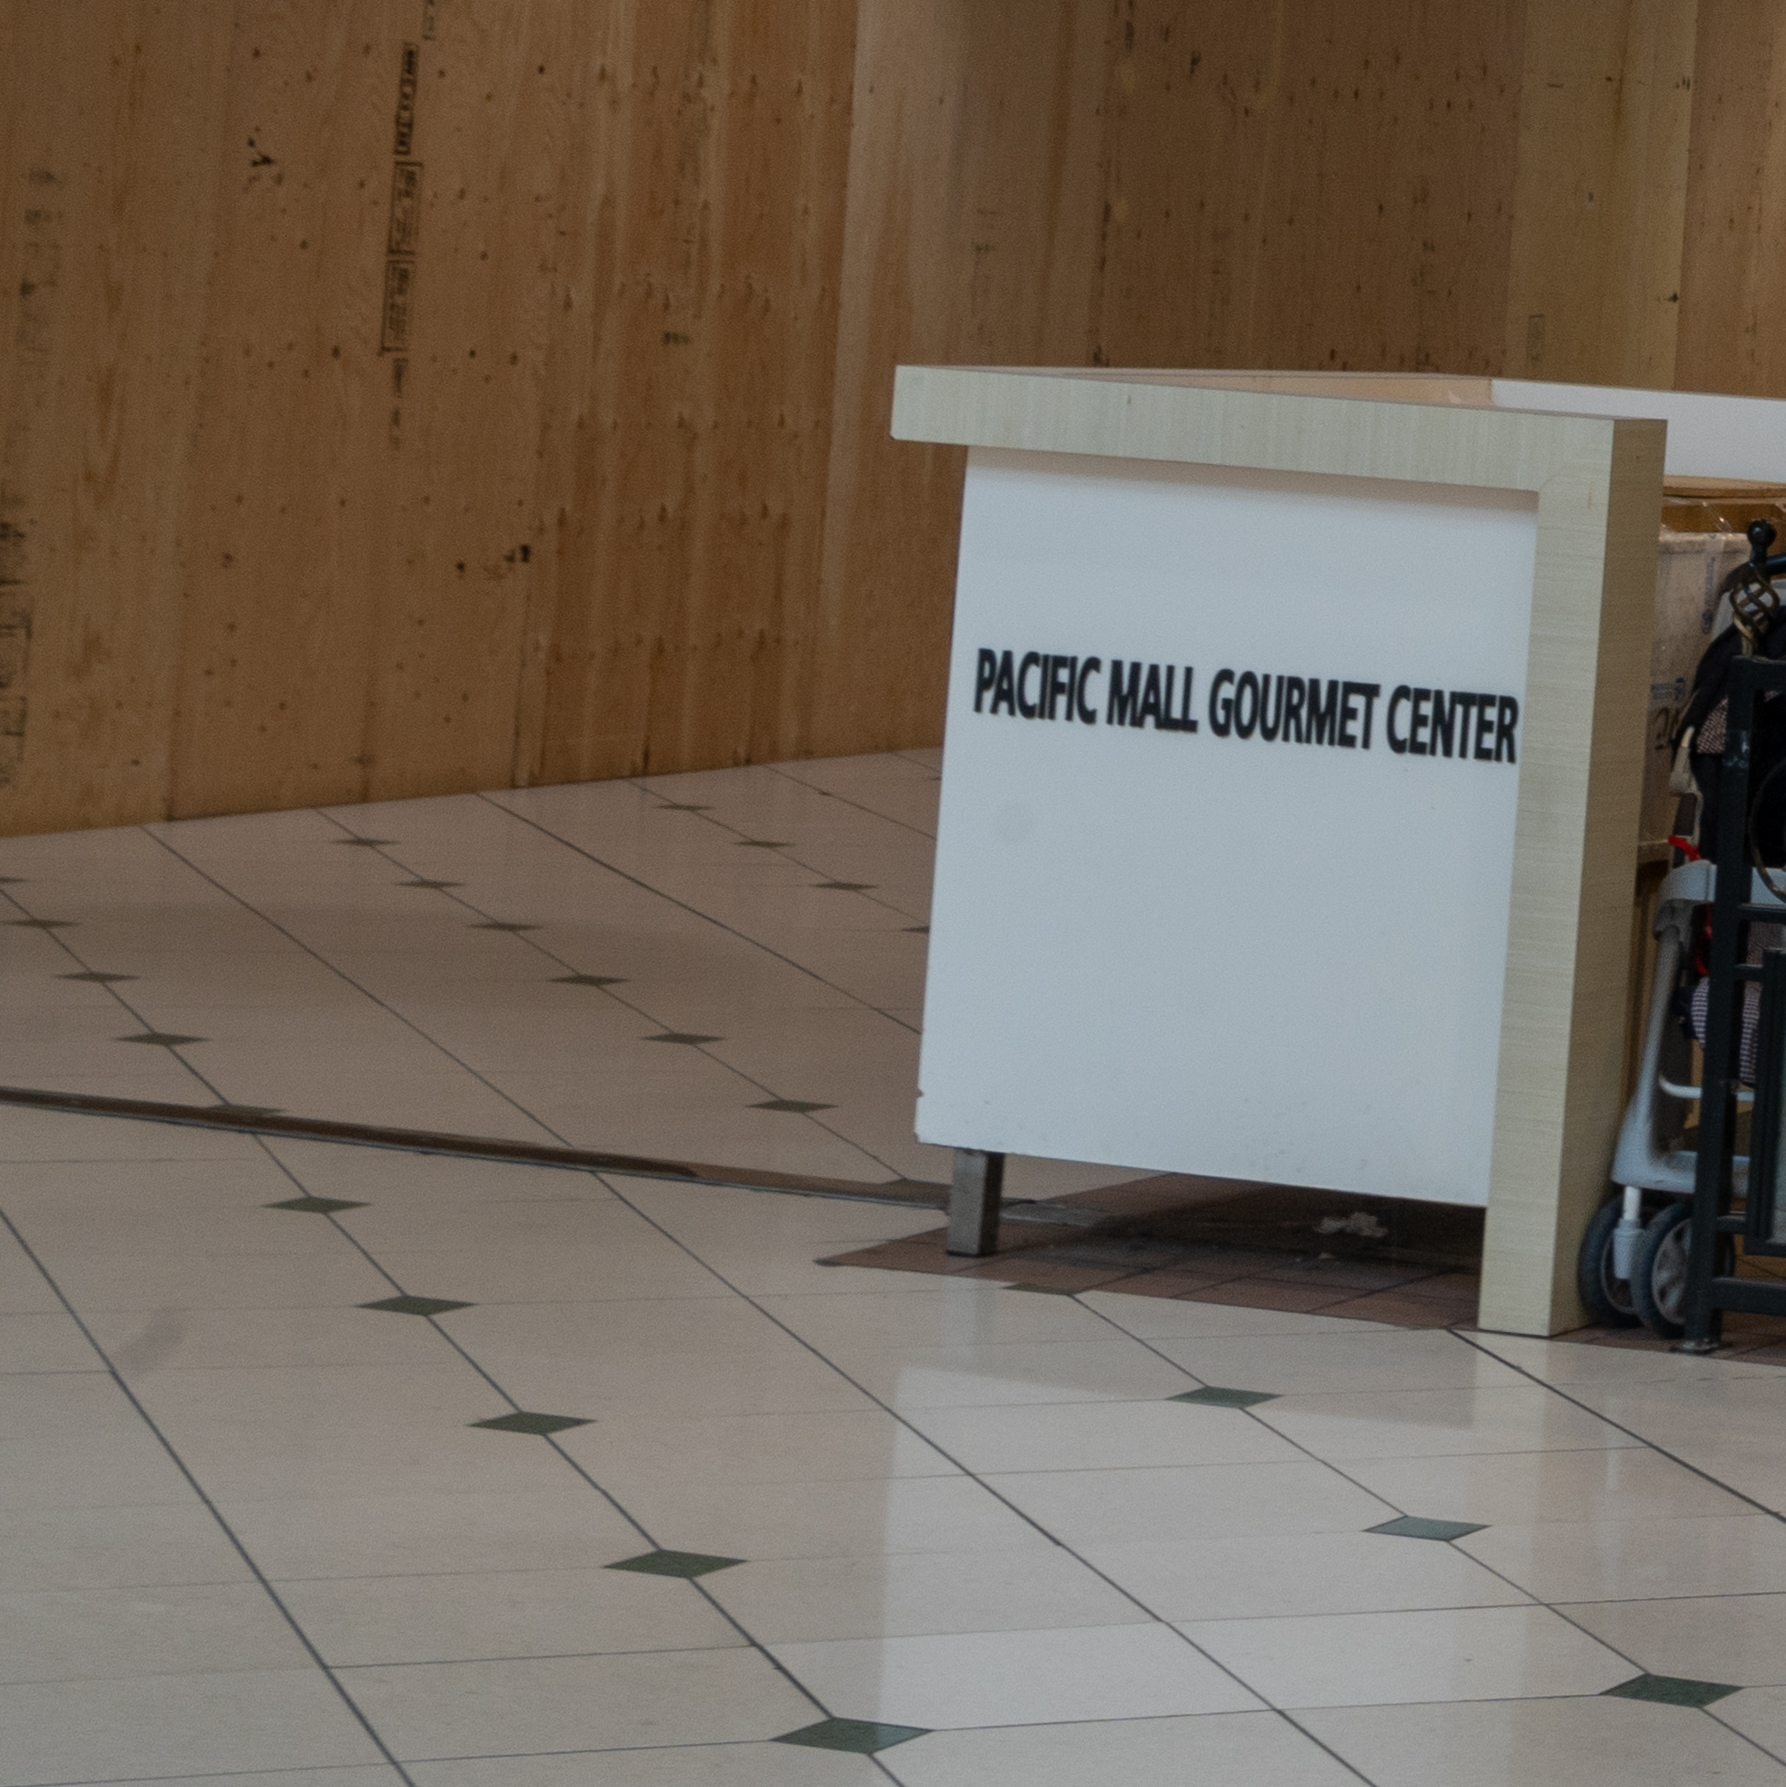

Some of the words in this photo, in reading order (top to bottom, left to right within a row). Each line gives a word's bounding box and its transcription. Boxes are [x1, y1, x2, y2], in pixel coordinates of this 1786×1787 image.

[972, 646, 1102, 725] PACIFIC
[1105, 657, 1199, 733] MALL
[1208, 668, 1380, 750] GOURMET
[1386, 683, 1520, 764] CENTER
